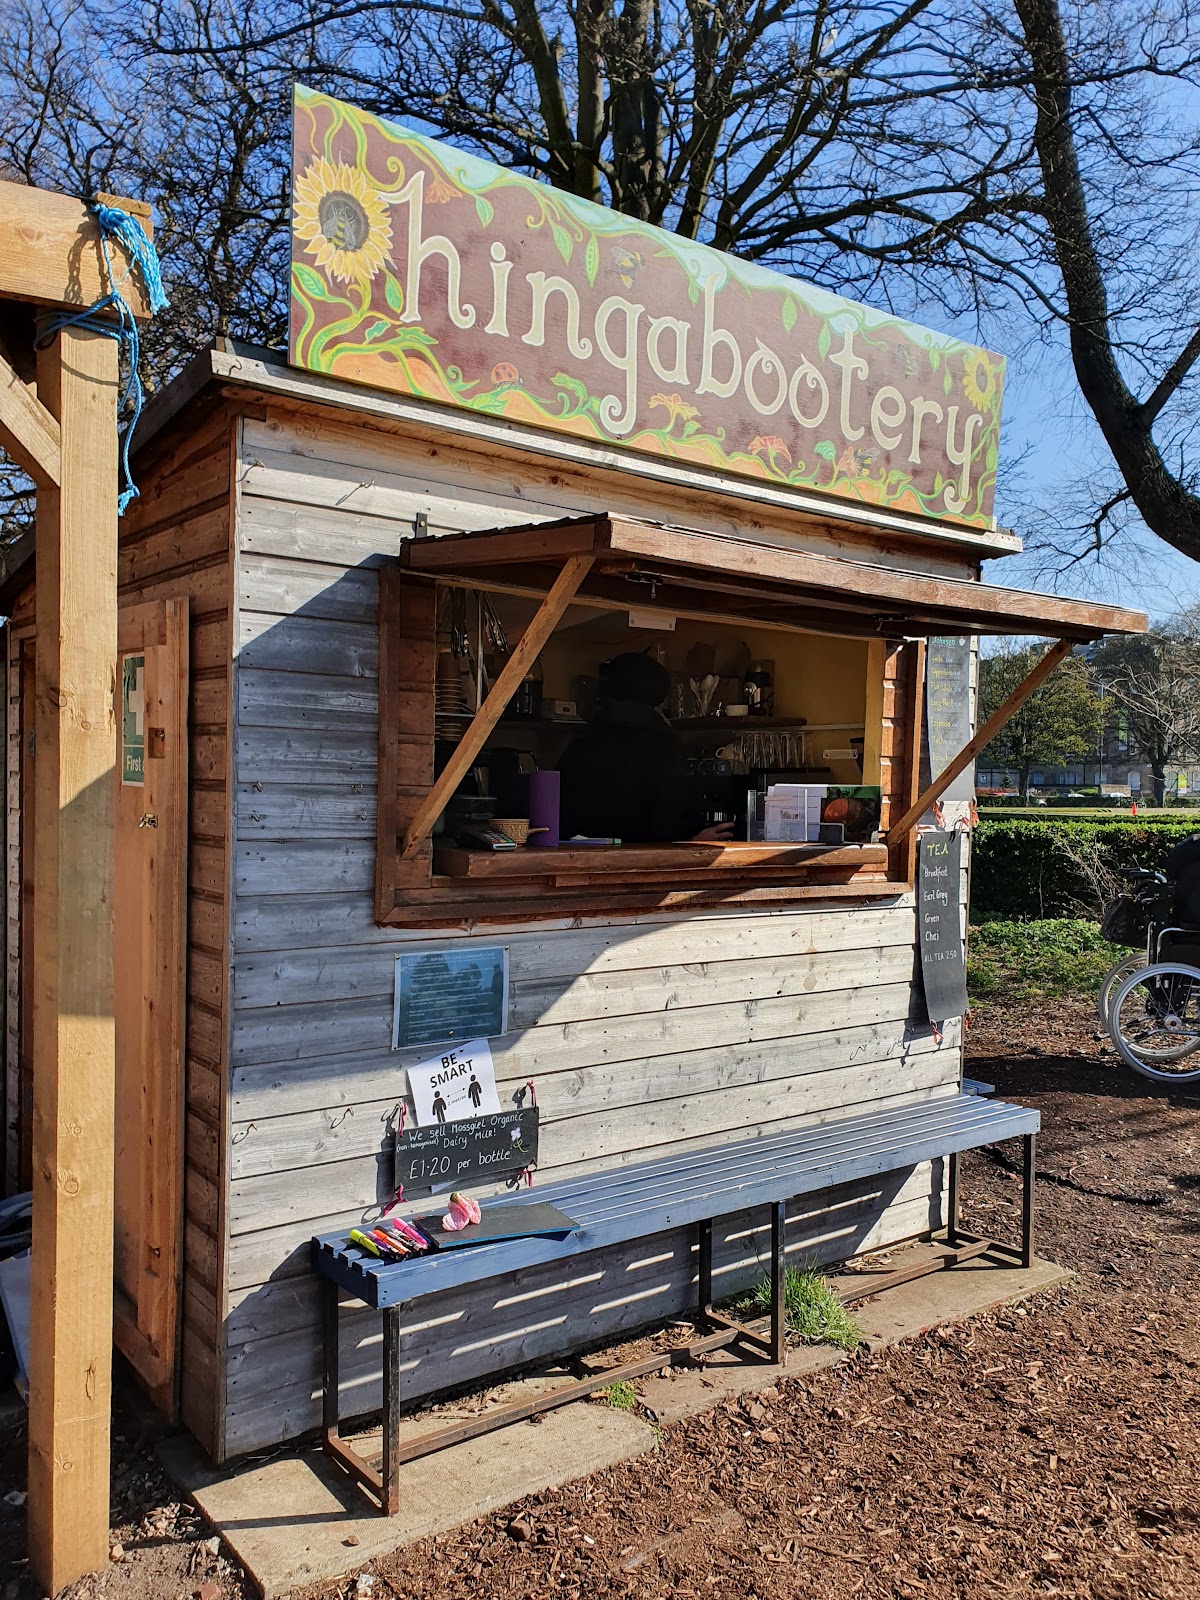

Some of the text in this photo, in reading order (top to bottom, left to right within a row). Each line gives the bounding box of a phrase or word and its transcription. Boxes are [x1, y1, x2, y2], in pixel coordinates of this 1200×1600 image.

[380, 169, 986, 513] hingabootery
[930, 697, 942, 711] Long
[930, 716, 951, 730] Espresso
[931, 735, 947, 745] Mocha
[127, 755, 141, 772] First
[926, 842, 949, 857] TEA
[924, 865, 949, 883] Breakfast
[923, 889, 949, 907] Earl Grey
[924, 912, 940, 924] Green
[925, 929, 940, 942] Chai
[923, 953, 933, 963] ALL
[933, 952, 945, 961] TEA
[440, 1052, 458, 1069] BE
[429, 1059, 474, 1089] SMART
[451, 1094, 467, 1104] metres
[408, 1111, 524, 1142] We sell Mossgiel Organic
[443, 1135, 468, 1150] Dairy
[457, 1158, 472, 1174] per
[478, 1148, 511, 1165] bottle
